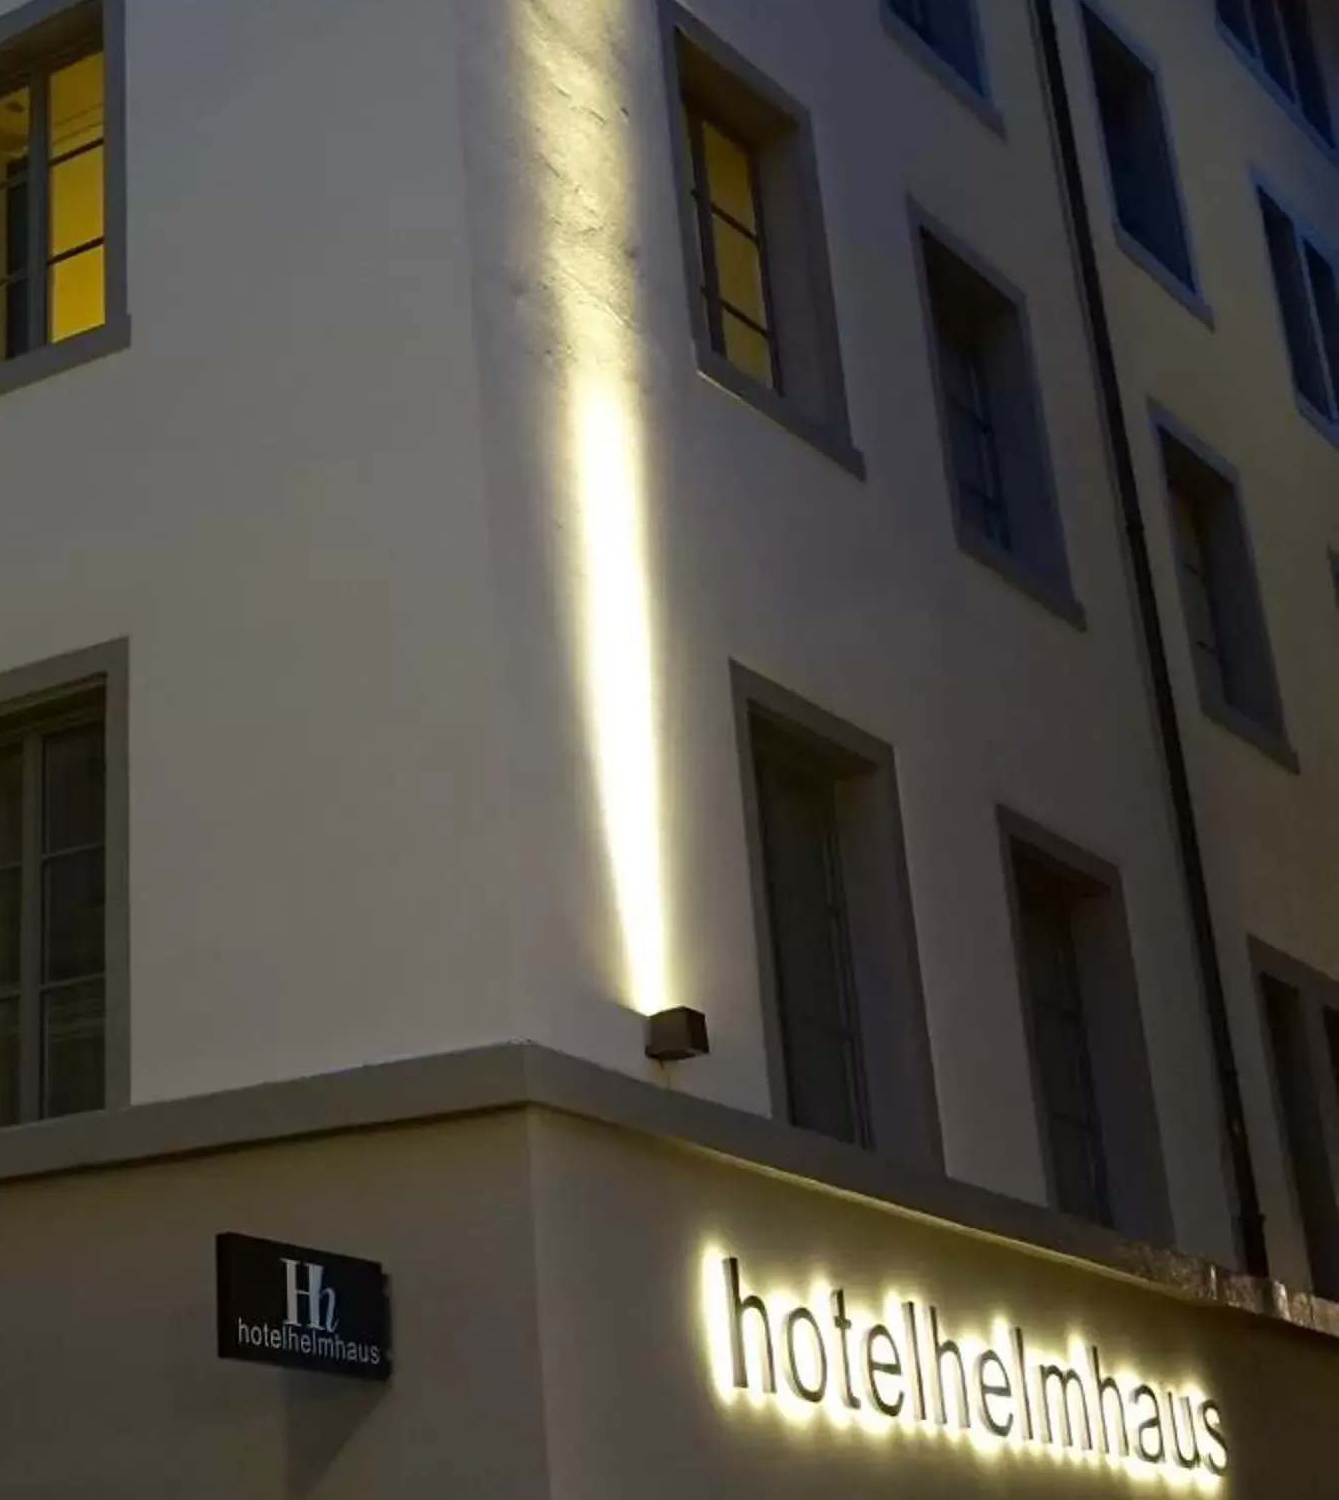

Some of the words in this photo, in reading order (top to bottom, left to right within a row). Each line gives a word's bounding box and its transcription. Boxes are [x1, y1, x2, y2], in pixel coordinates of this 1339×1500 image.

[279, 1257, 339, 1333] Hh
[237, 1316, 381, 1365] hotelhelmhaus
[722, 1257, 1229, 1476] hotelhelmhaus
